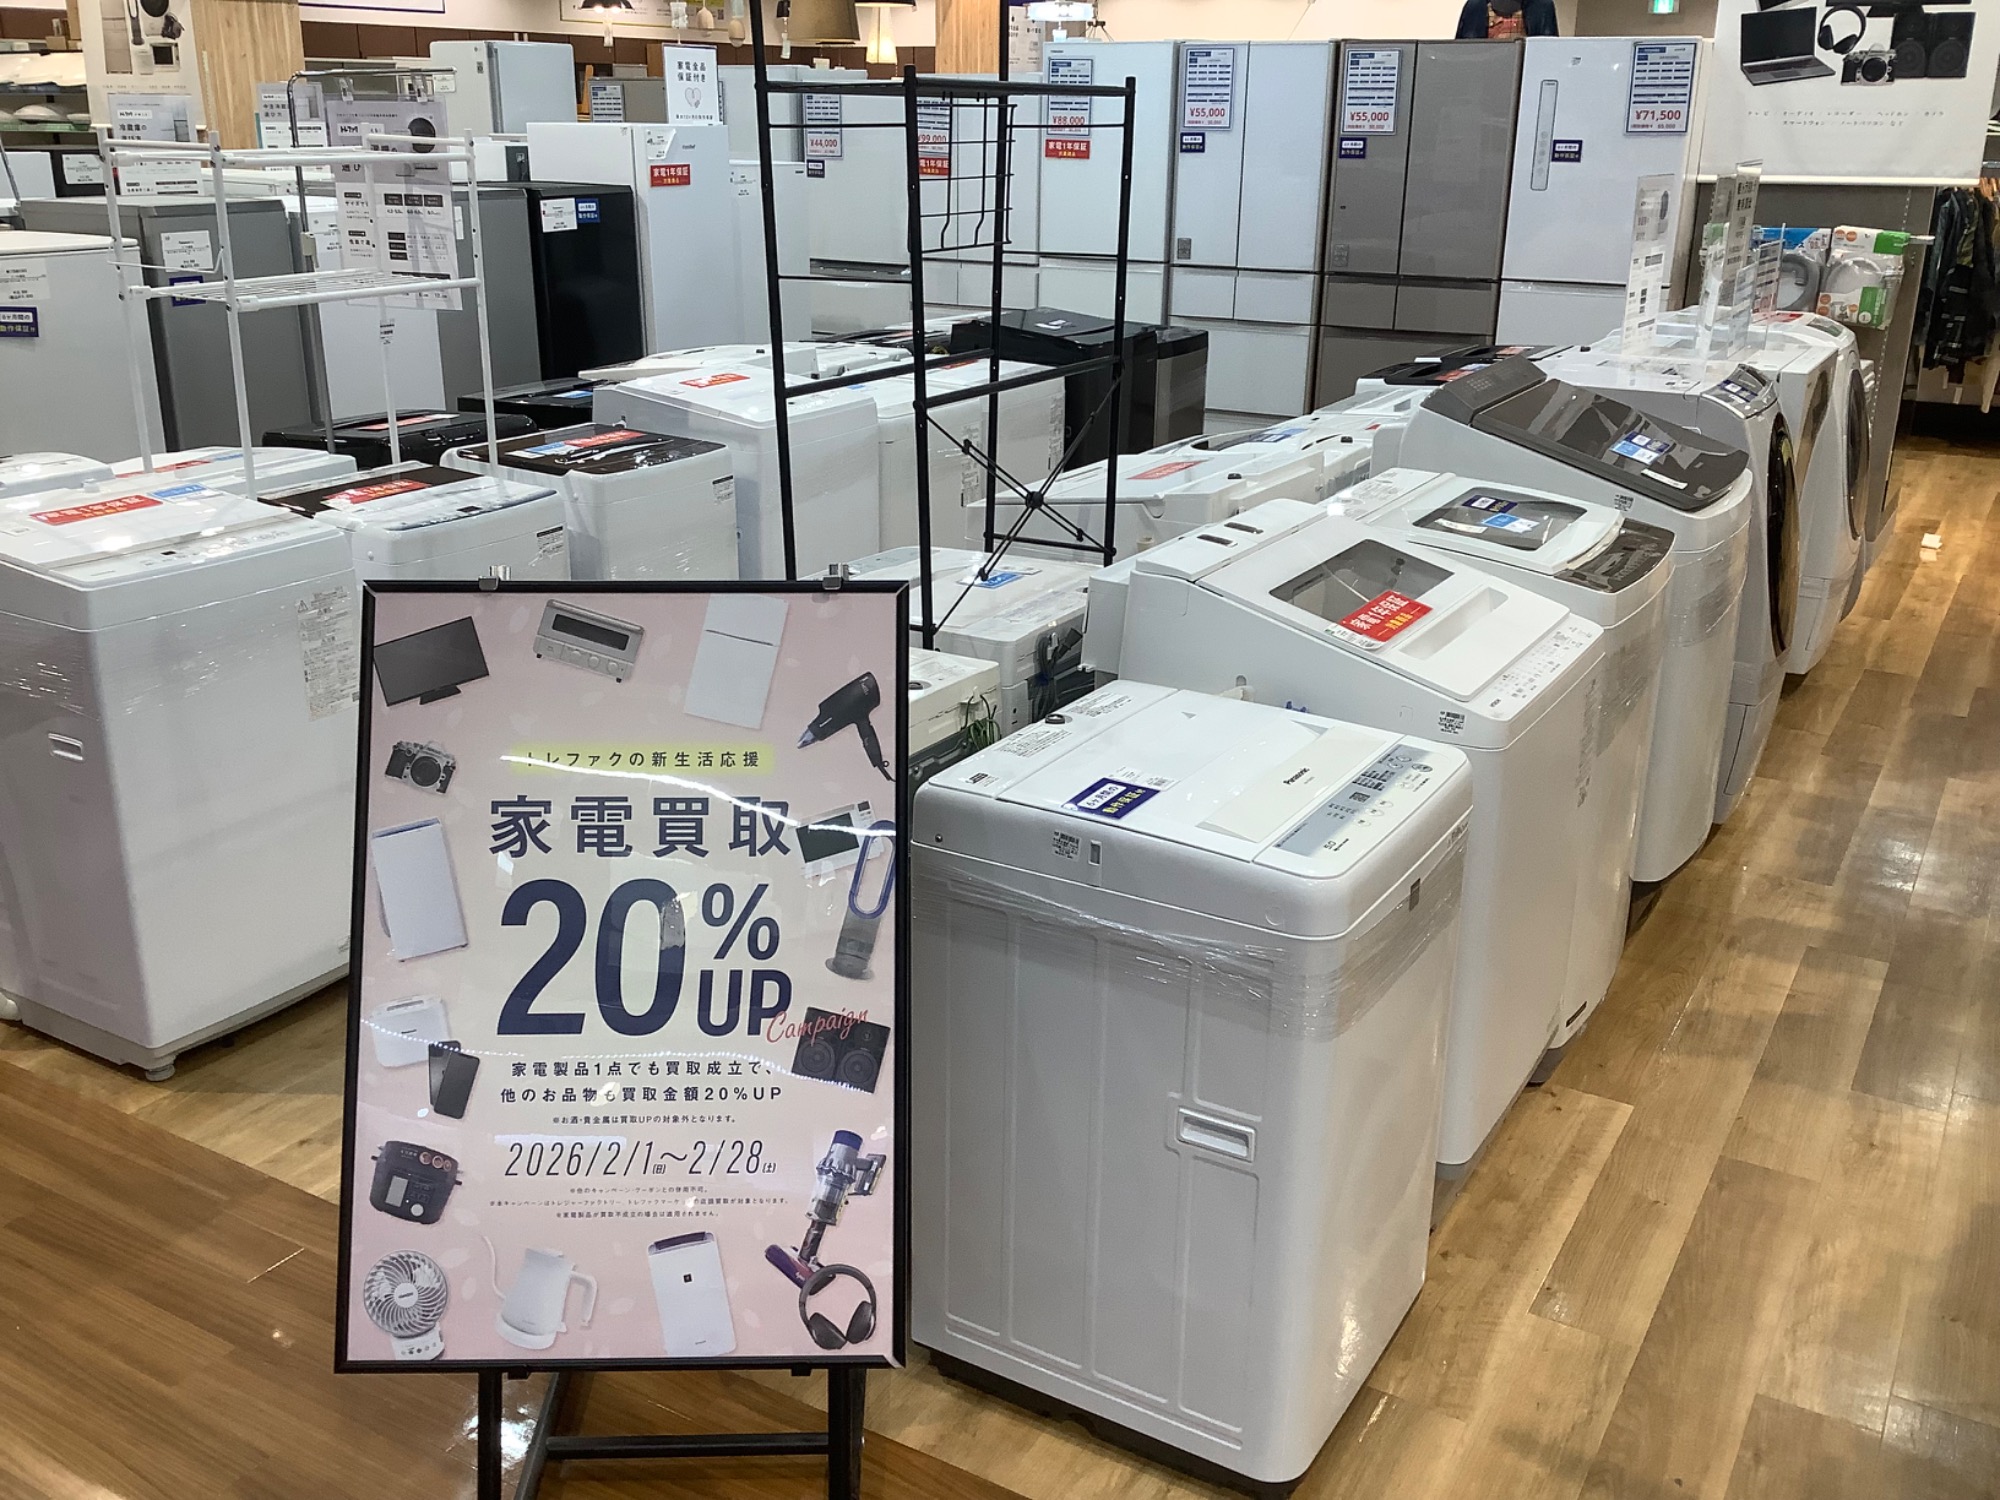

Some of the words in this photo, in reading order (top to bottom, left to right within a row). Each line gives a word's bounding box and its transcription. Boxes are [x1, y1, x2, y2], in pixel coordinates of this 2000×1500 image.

[677, 61, 706, 72] 家電全品
[1189, 108, 1226, 119] ¥55,000
[1349, 111, 1390, 122] ¥55,000
[1635, 109, 1682, 121] ¥71,500
[1048, 141, 1088, 151] 家電1年保証
[652, 168, 689, 177] 家電1年保証
[1350, 595, 1410, 631] 家電1年保証
[488, 795, 792, 859] 家電買取
[696, 968, 793, 1037] UP
[766, 1007, 869, 1047] Campaign
[511, 1060, 774, 1077] 家電製品1点でも買取成立で、
